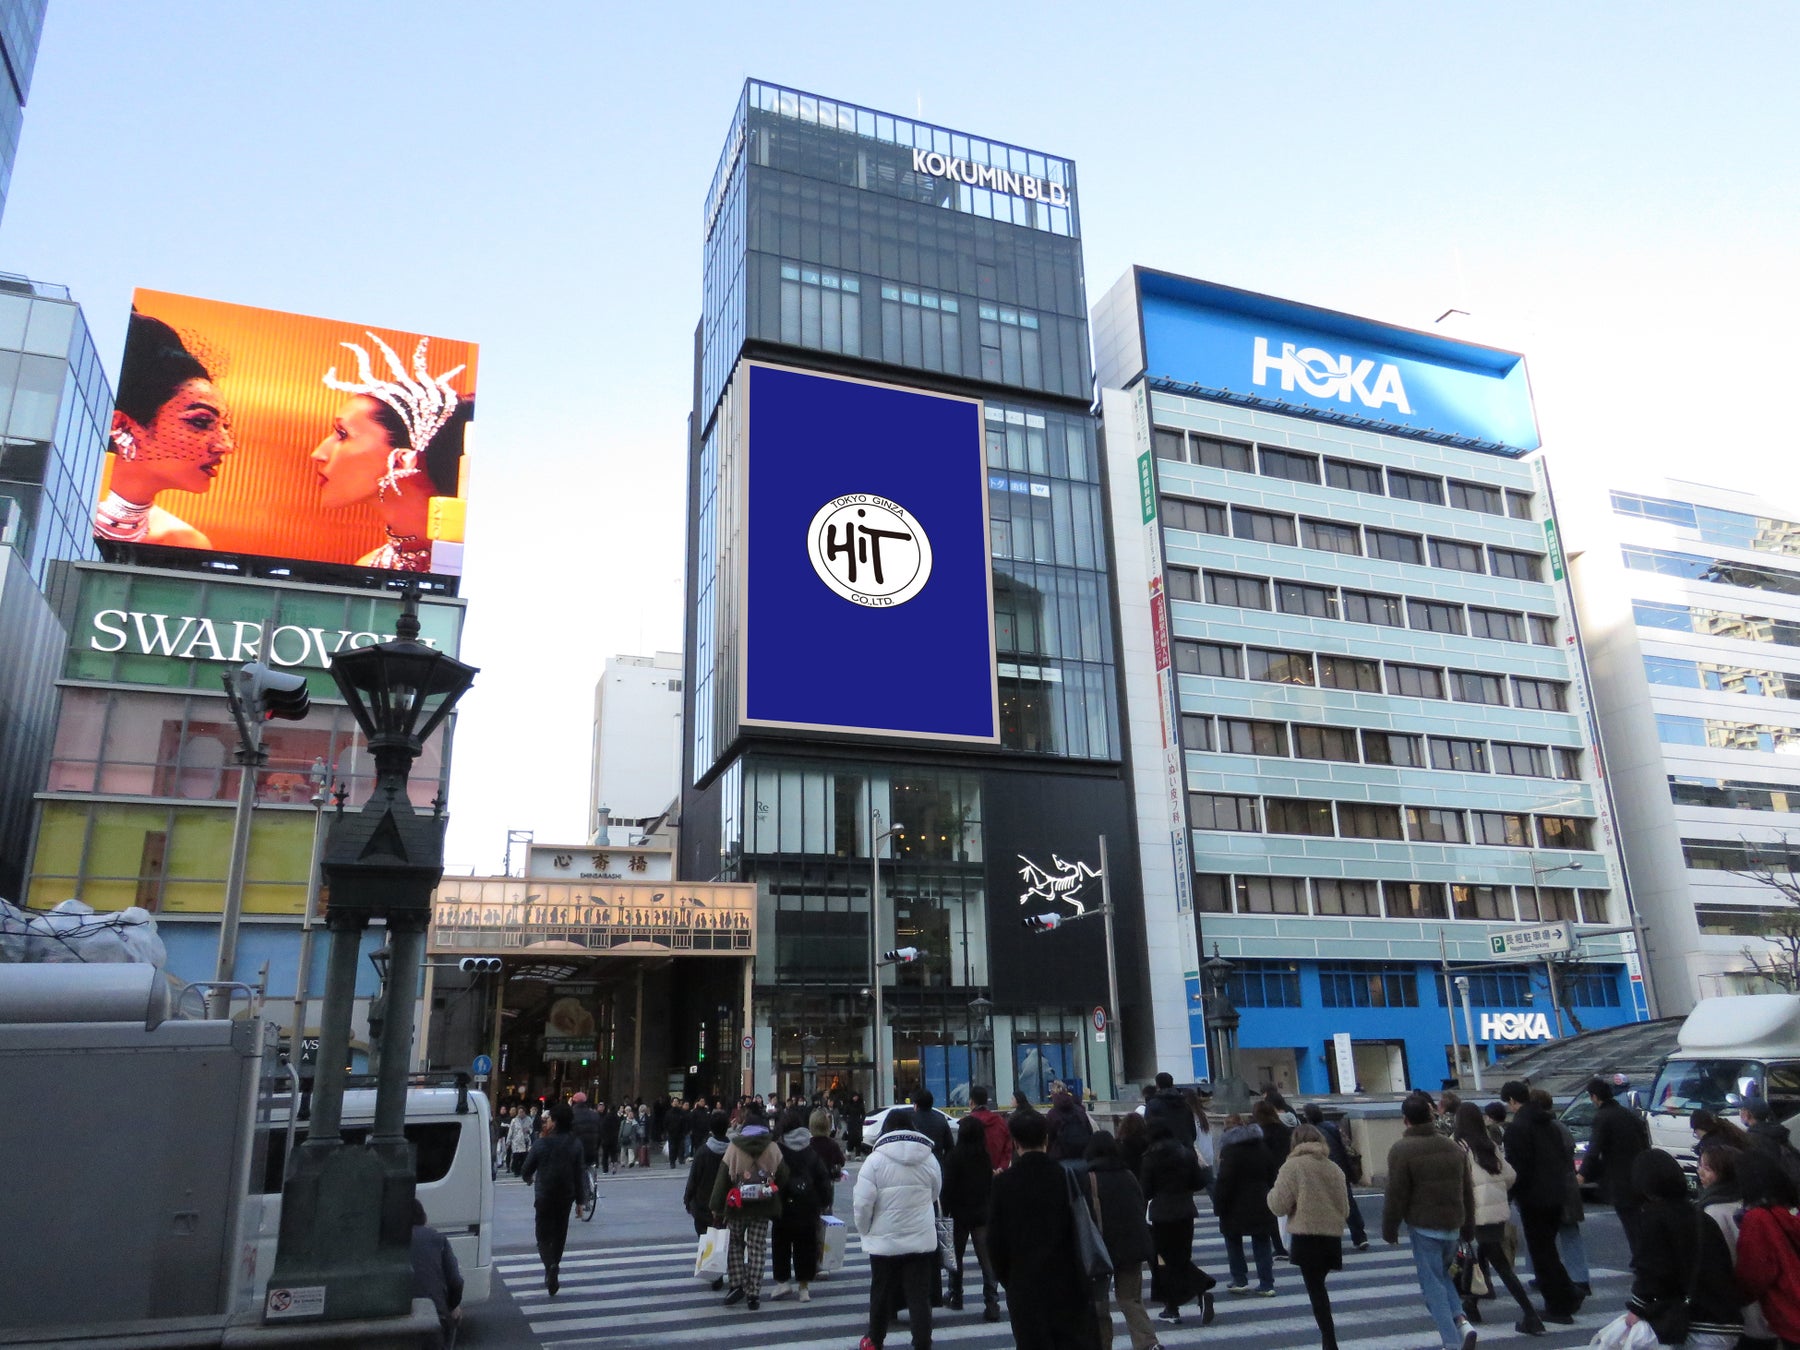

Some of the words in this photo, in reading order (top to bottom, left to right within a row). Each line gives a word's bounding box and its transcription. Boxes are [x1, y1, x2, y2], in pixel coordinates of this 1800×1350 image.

[912, 148, 1021, 196] KOKUMIN
[1023, 175, 1070, 207] BLD.
[1252, 336, 1412, 415] HOKA
[830, 494, 867, 510] TOKYO
[872, 496, 904, 518] GINZA
[91, 609, 437, 670] SWAROV
[1167, 752, 1180, 824] いぬい皮フ科
[553, 852, 648, 872] 心斎橋
[1480, 1012, 1553, 1040] HOKA
